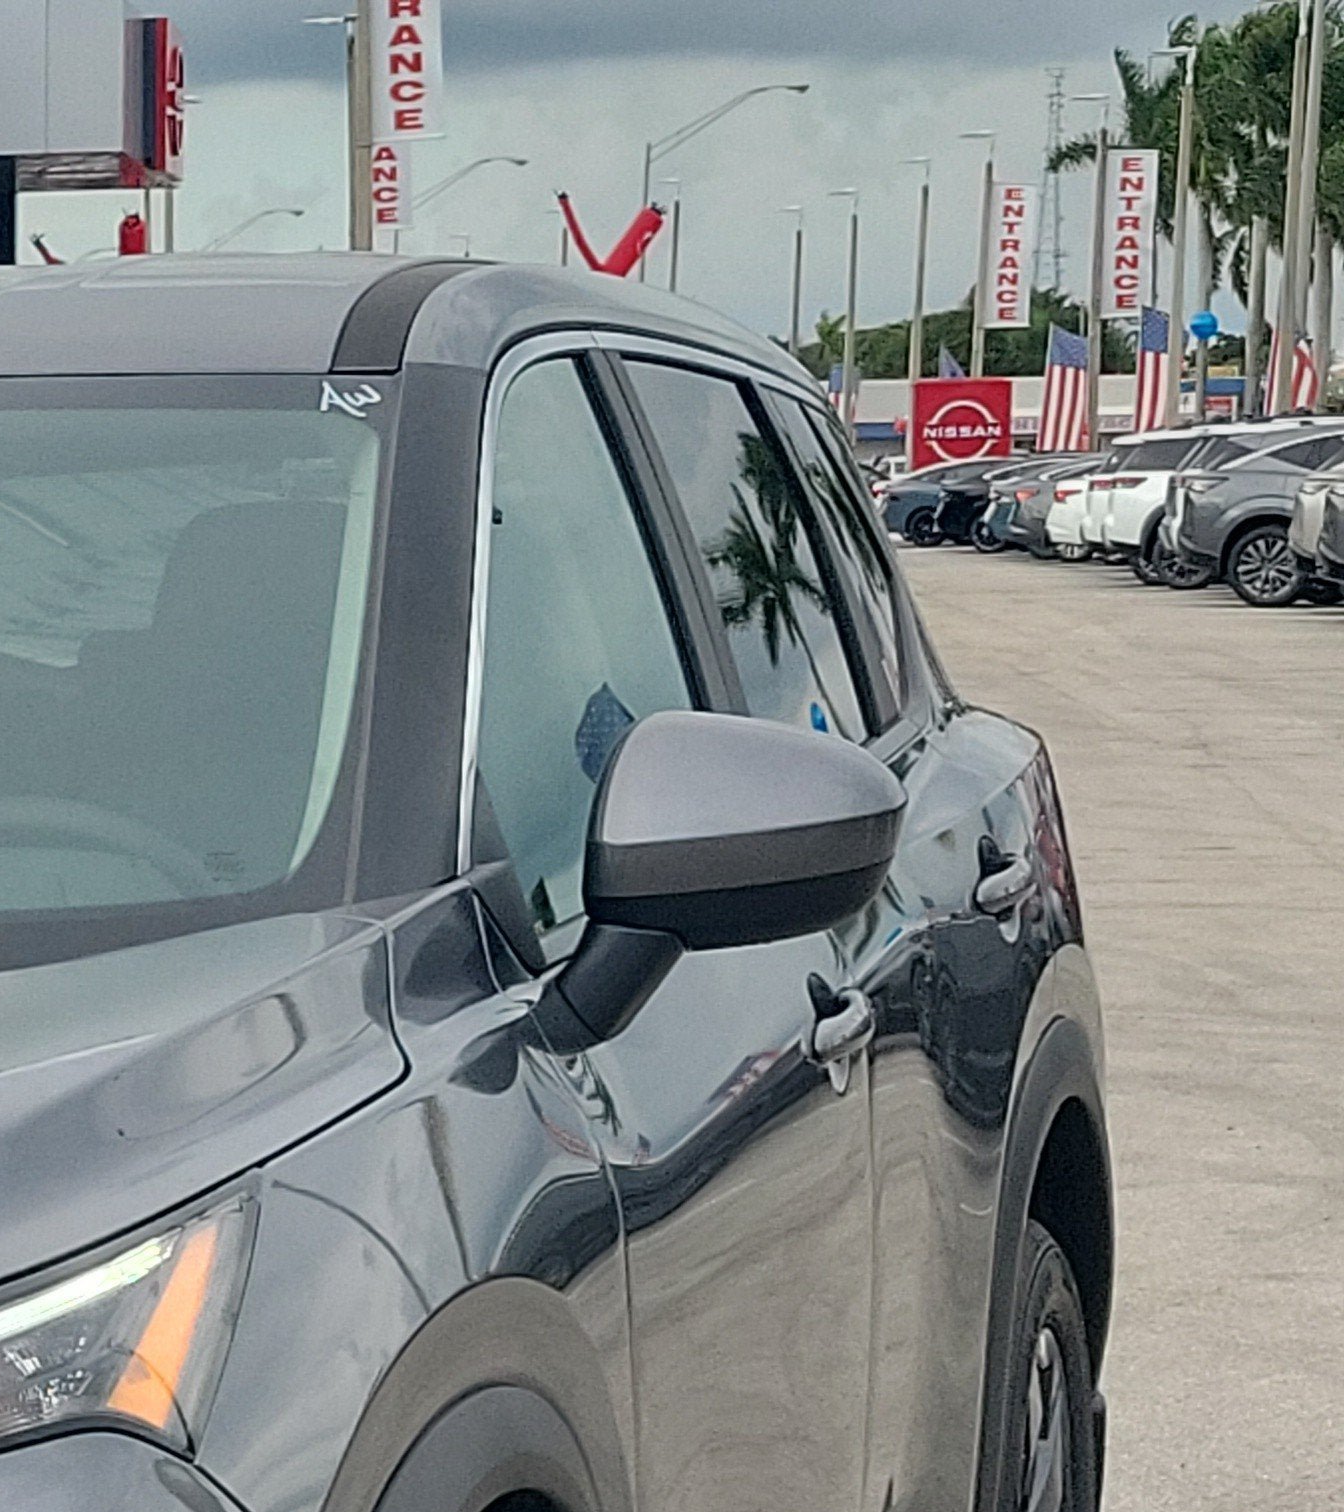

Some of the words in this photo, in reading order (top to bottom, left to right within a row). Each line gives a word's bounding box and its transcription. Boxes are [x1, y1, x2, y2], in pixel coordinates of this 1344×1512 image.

[996, 188, 1025, 320] ENTRANCE
[1113, 157, 1144, 309] ENTRANCE
[922, 424, 1002, 439] NISSAN
